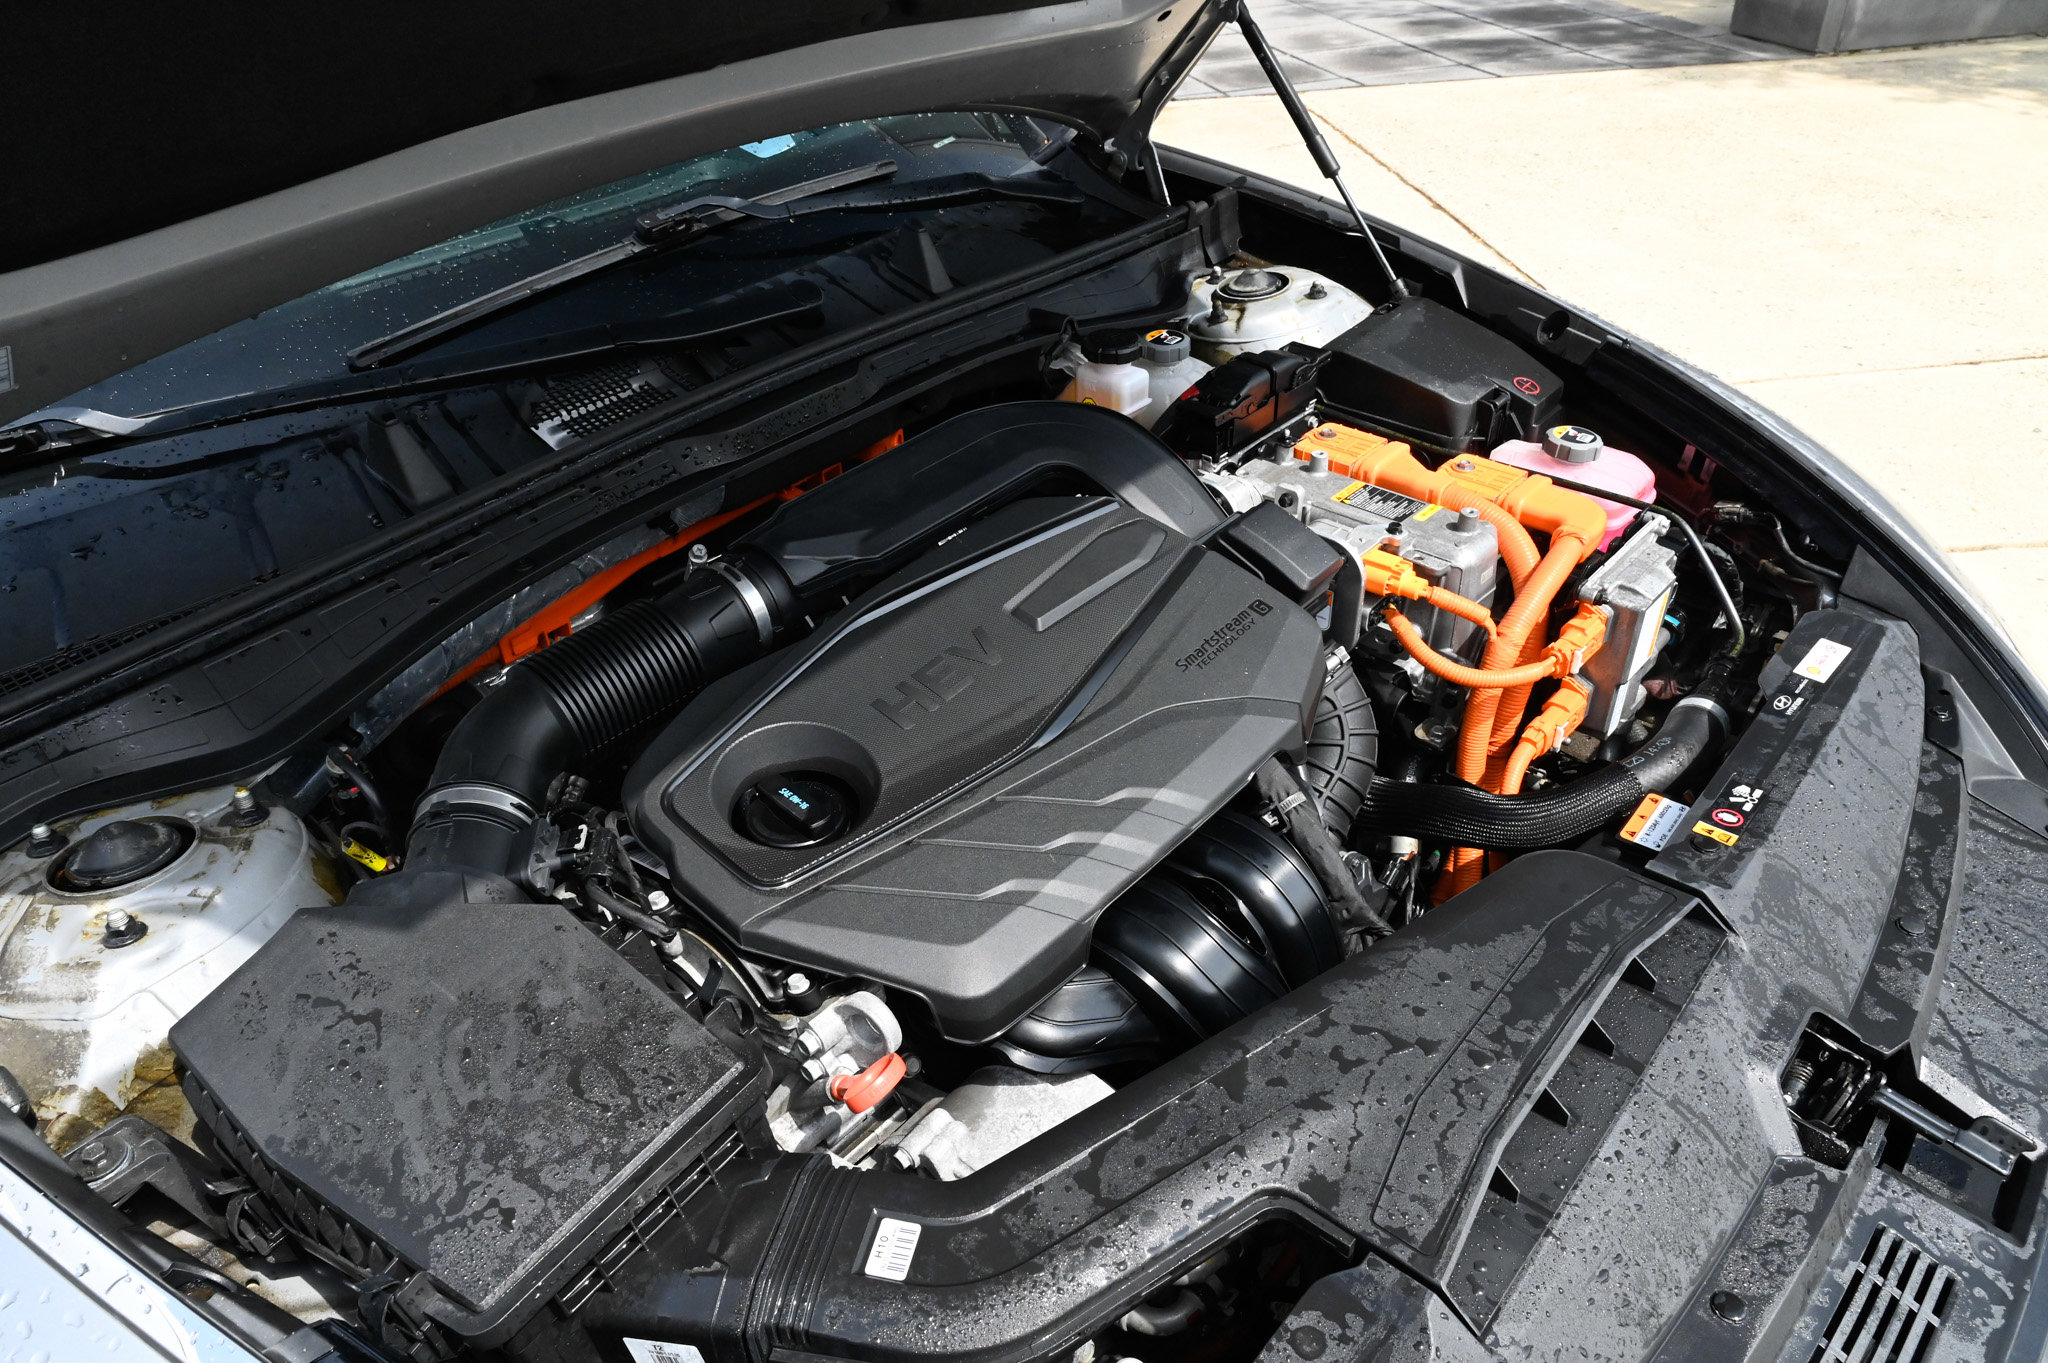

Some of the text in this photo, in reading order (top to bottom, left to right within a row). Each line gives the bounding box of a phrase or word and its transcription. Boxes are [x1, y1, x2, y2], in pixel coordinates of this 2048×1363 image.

[1175, 600, 1272, 672] Smartstream G
[1195, 617, 1257, 670] TECHNOLOGY
[870, 625, 1002, 731] HEV
[778, 787, 794, 799] SAE
[874, 1235, 889, 1258] H10
